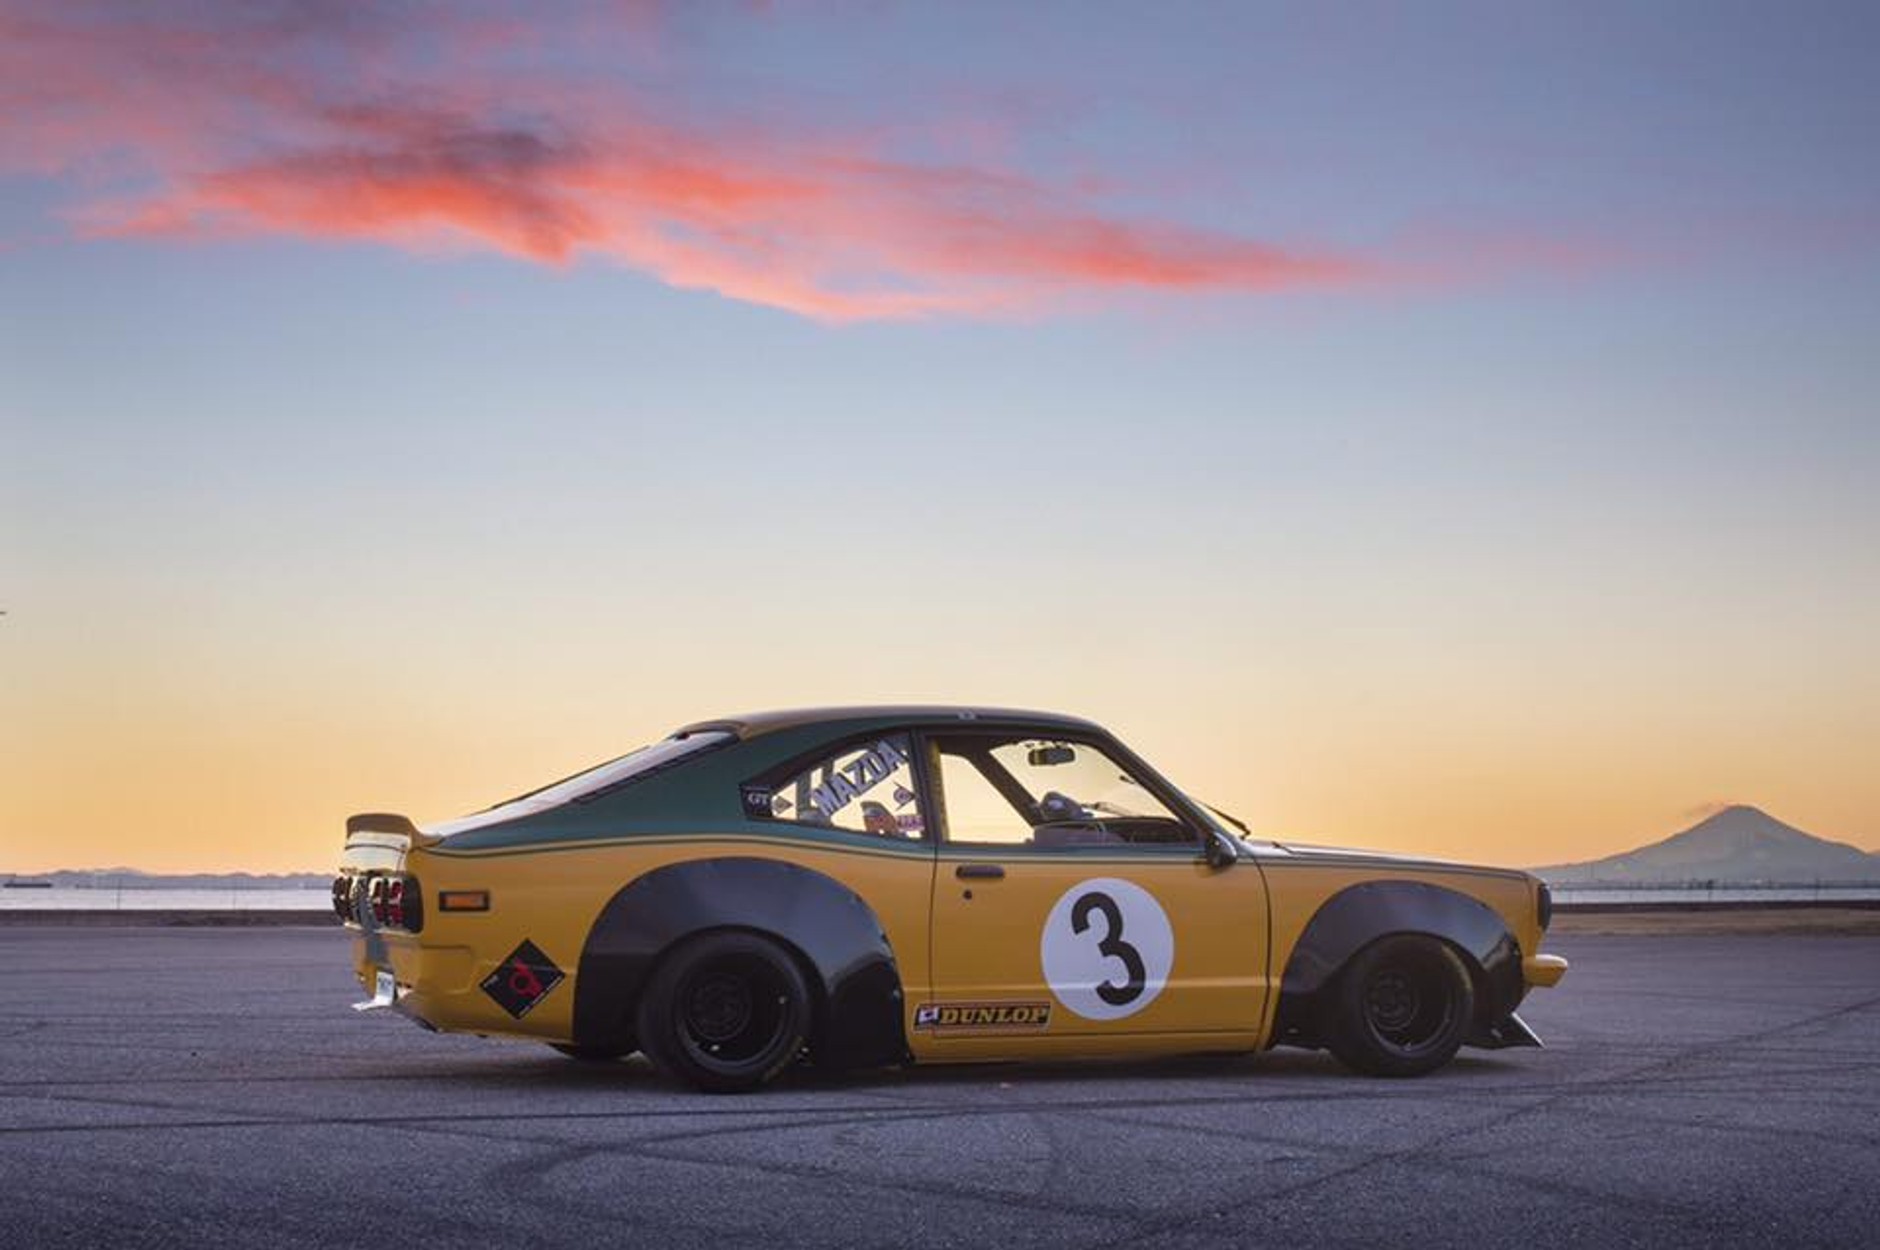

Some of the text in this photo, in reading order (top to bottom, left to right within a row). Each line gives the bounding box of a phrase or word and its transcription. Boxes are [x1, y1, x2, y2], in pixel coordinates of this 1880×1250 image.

[812, 739, 910, 817] MAZDA
[1071, 892, 1146, 1006] 3
[941, 1008, 1049, 1024] DUNLOP
